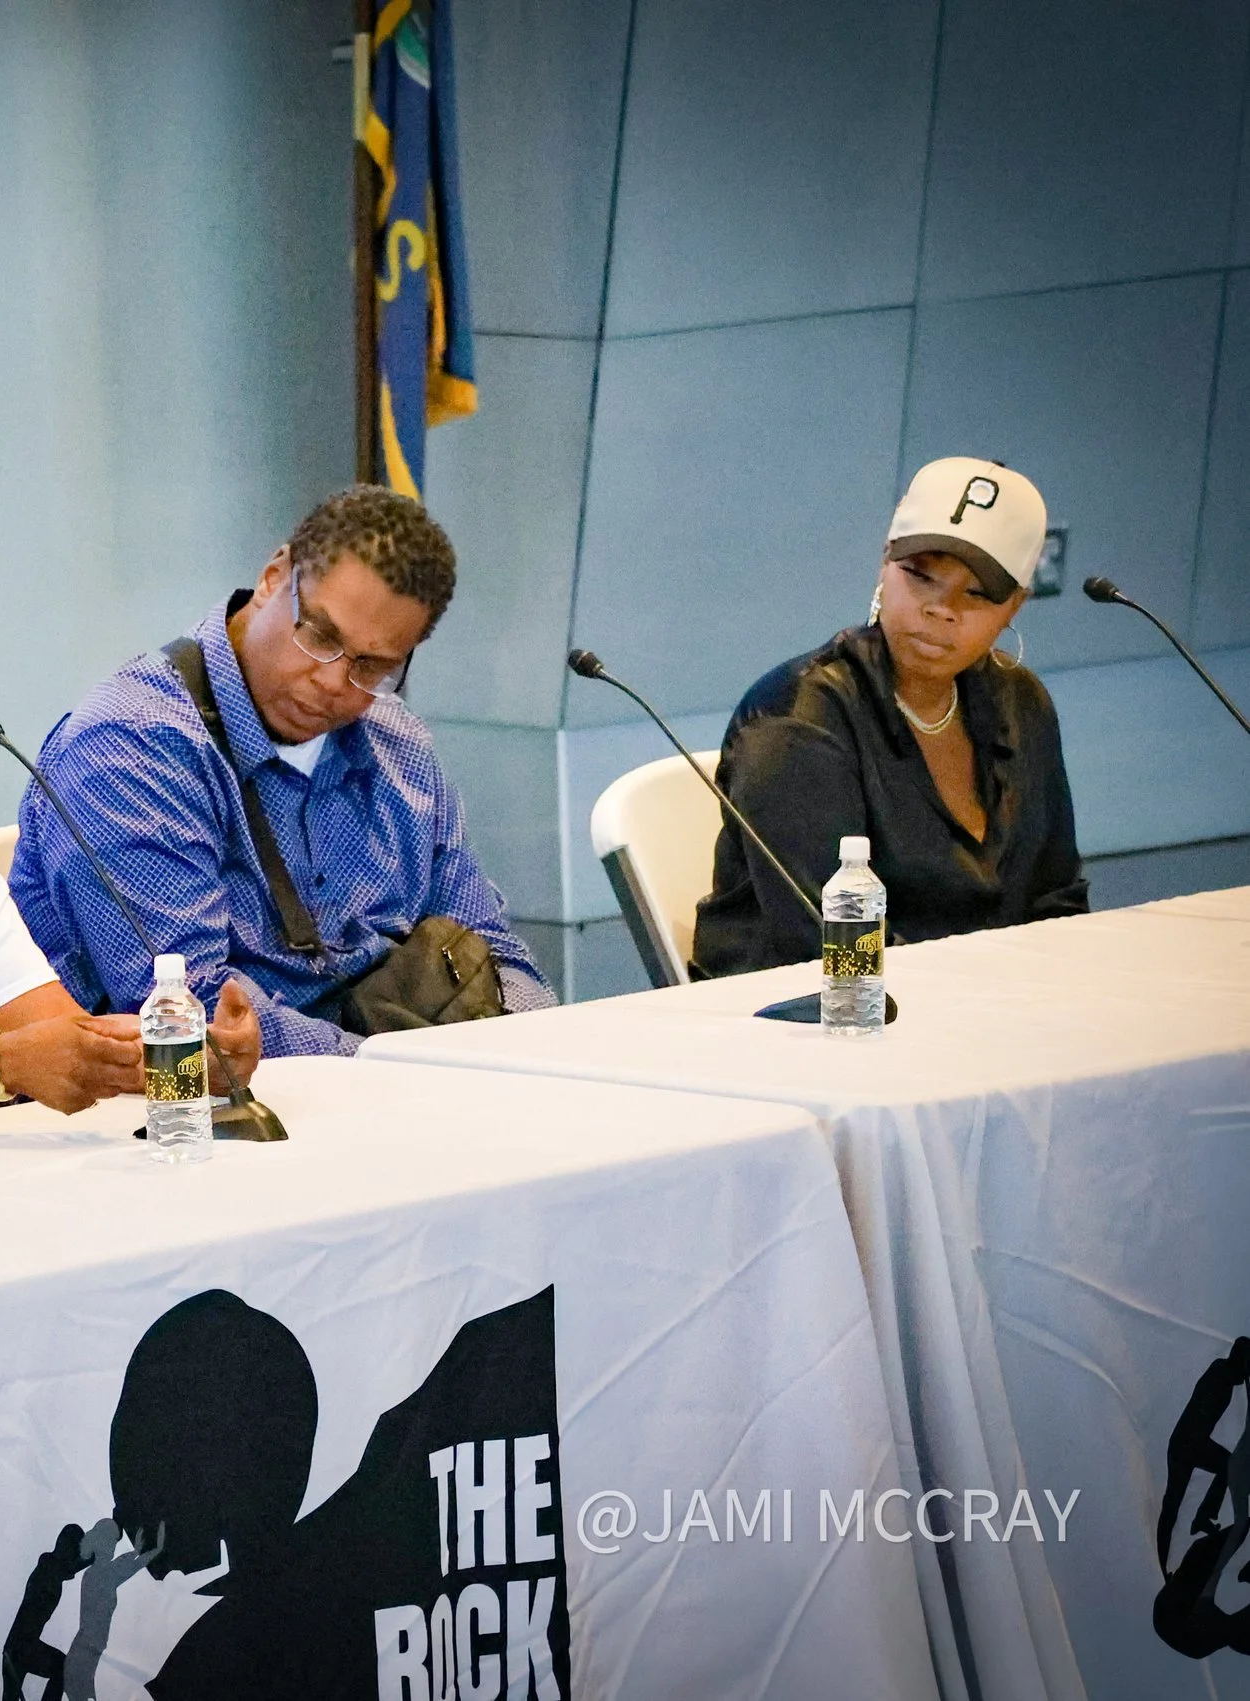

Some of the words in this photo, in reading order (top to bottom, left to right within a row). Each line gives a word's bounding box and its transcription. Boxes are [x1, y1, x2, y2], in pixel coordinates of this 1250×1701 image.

[950, 476, 999, 525] P
[429, 1433, 556, 1578] THE
[374, 1576, 562, 1701] ROCK
